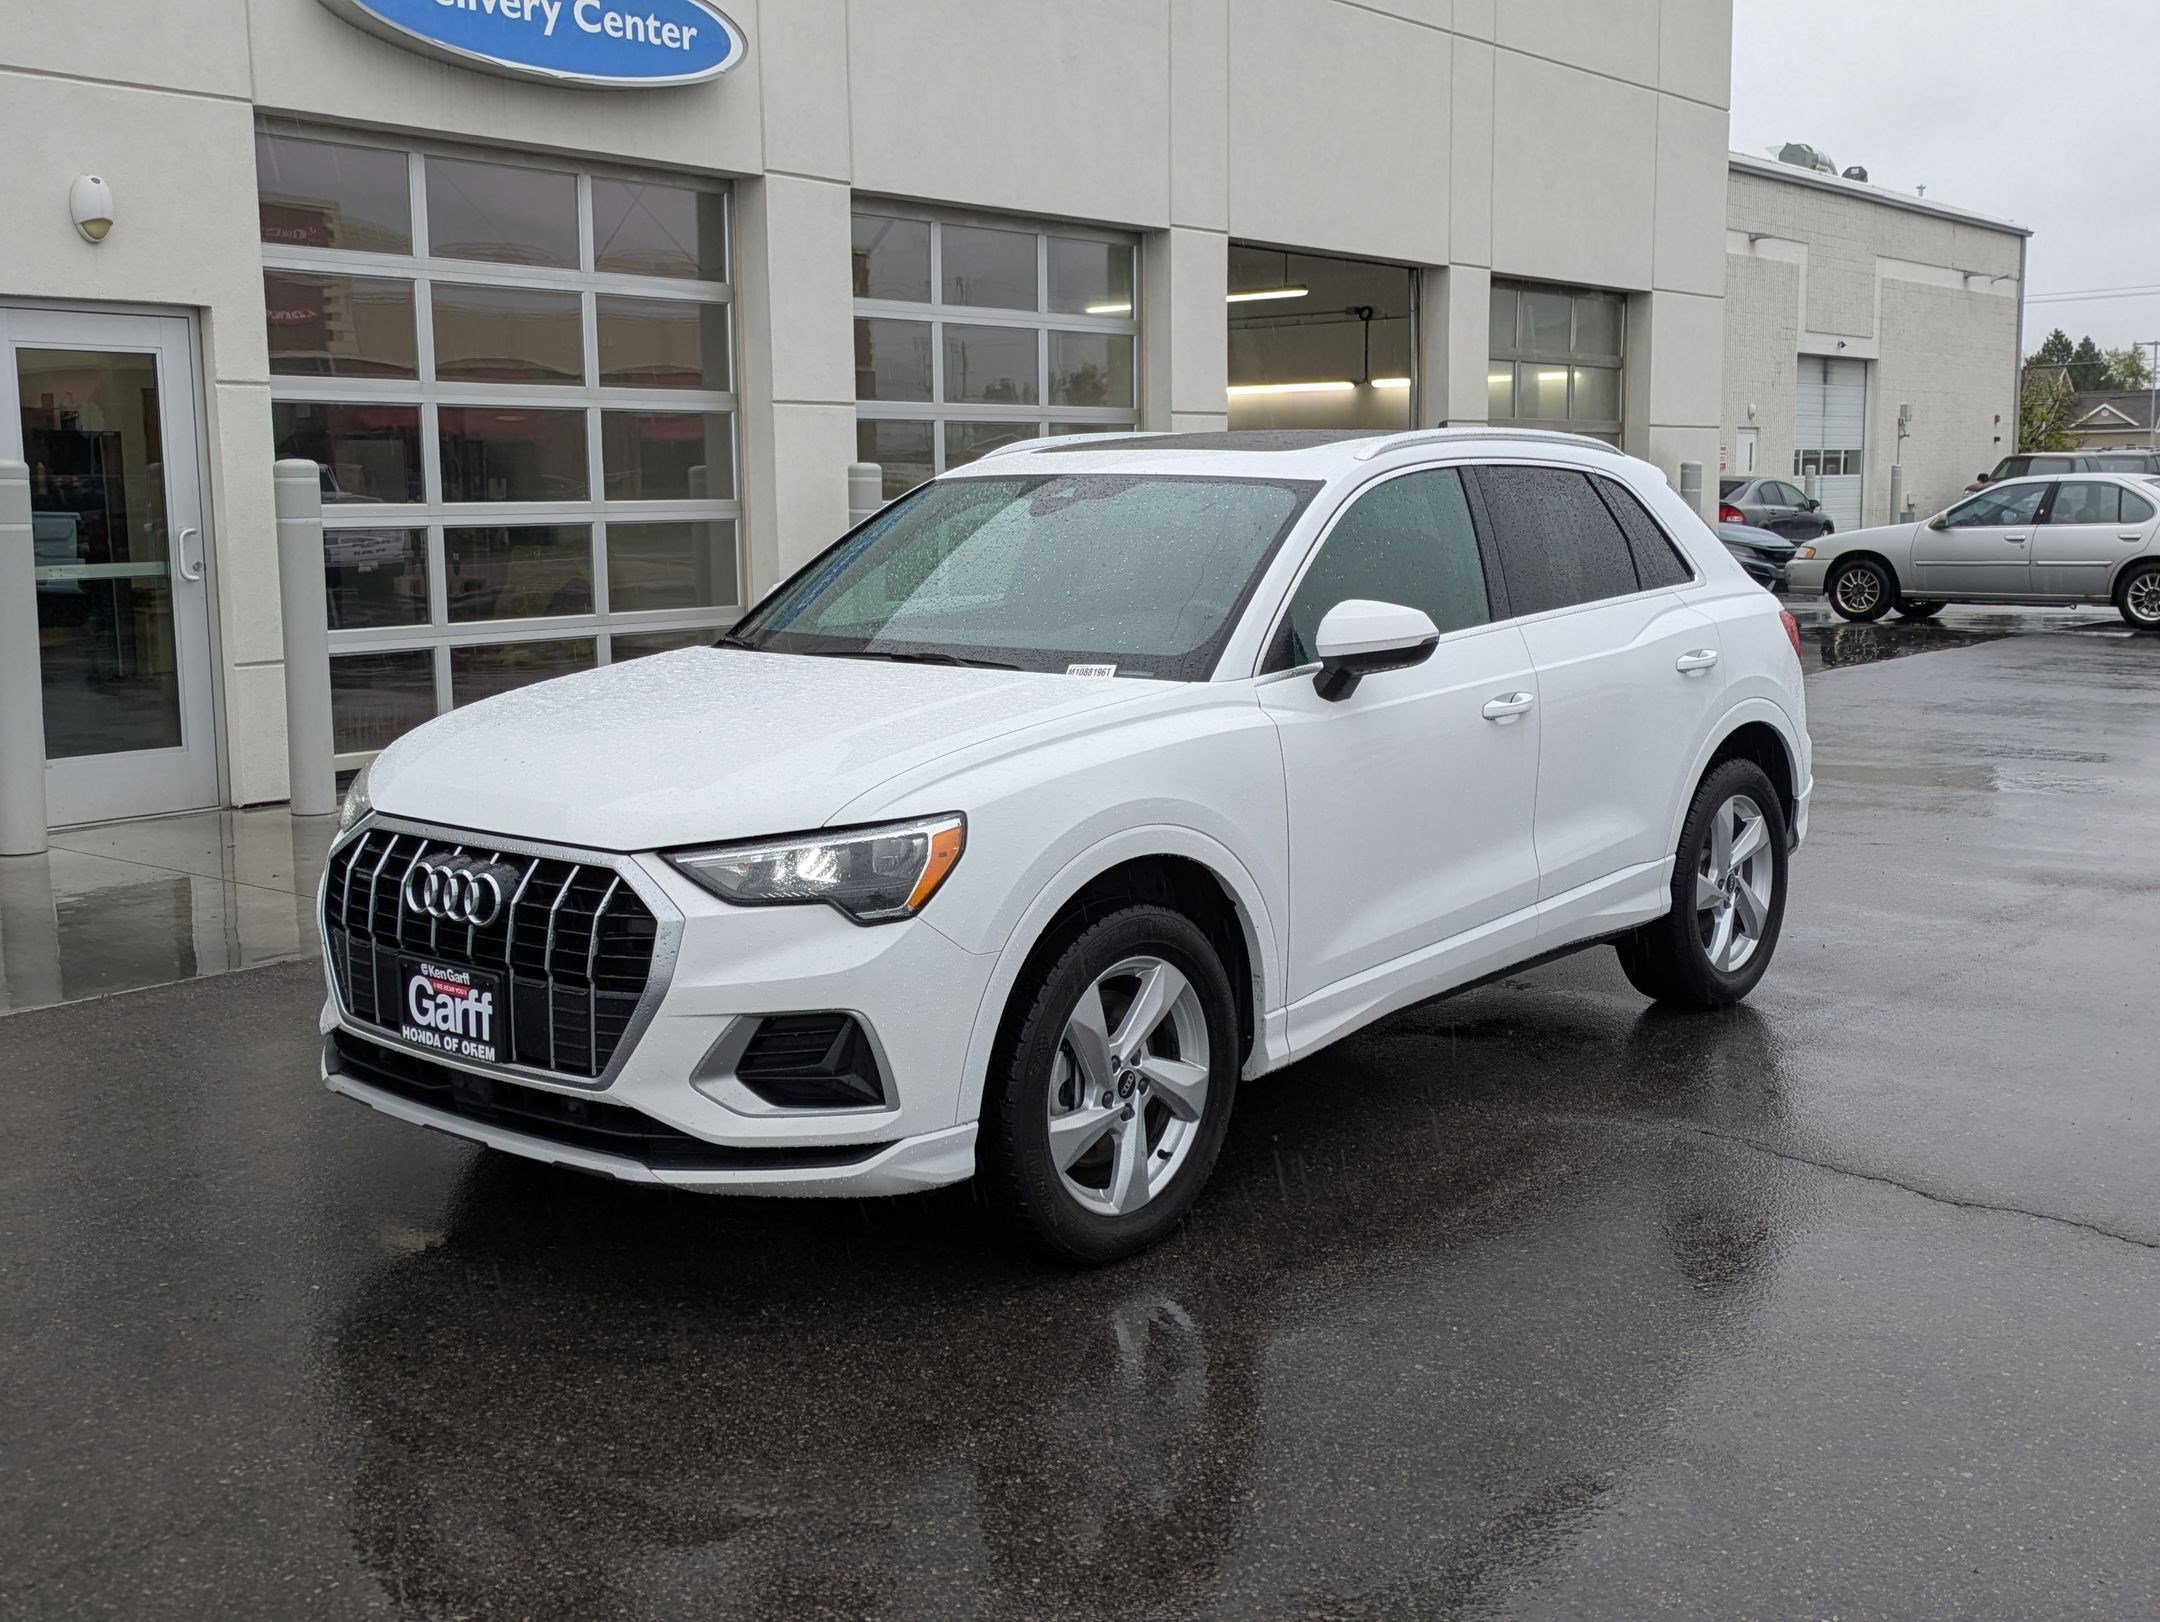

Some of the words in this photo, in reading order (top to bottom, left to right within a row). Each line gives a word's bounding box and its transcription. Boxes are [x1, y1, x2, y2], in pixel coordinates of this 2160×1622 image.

[573, 0, 698, 50] Center
[408, 975, 493, 1041] Garff
[402, 1025, 442, 1048] HONDA
[443, 1037, 459, 1052] OF
[461, 1040, 496, 1062] OREM
